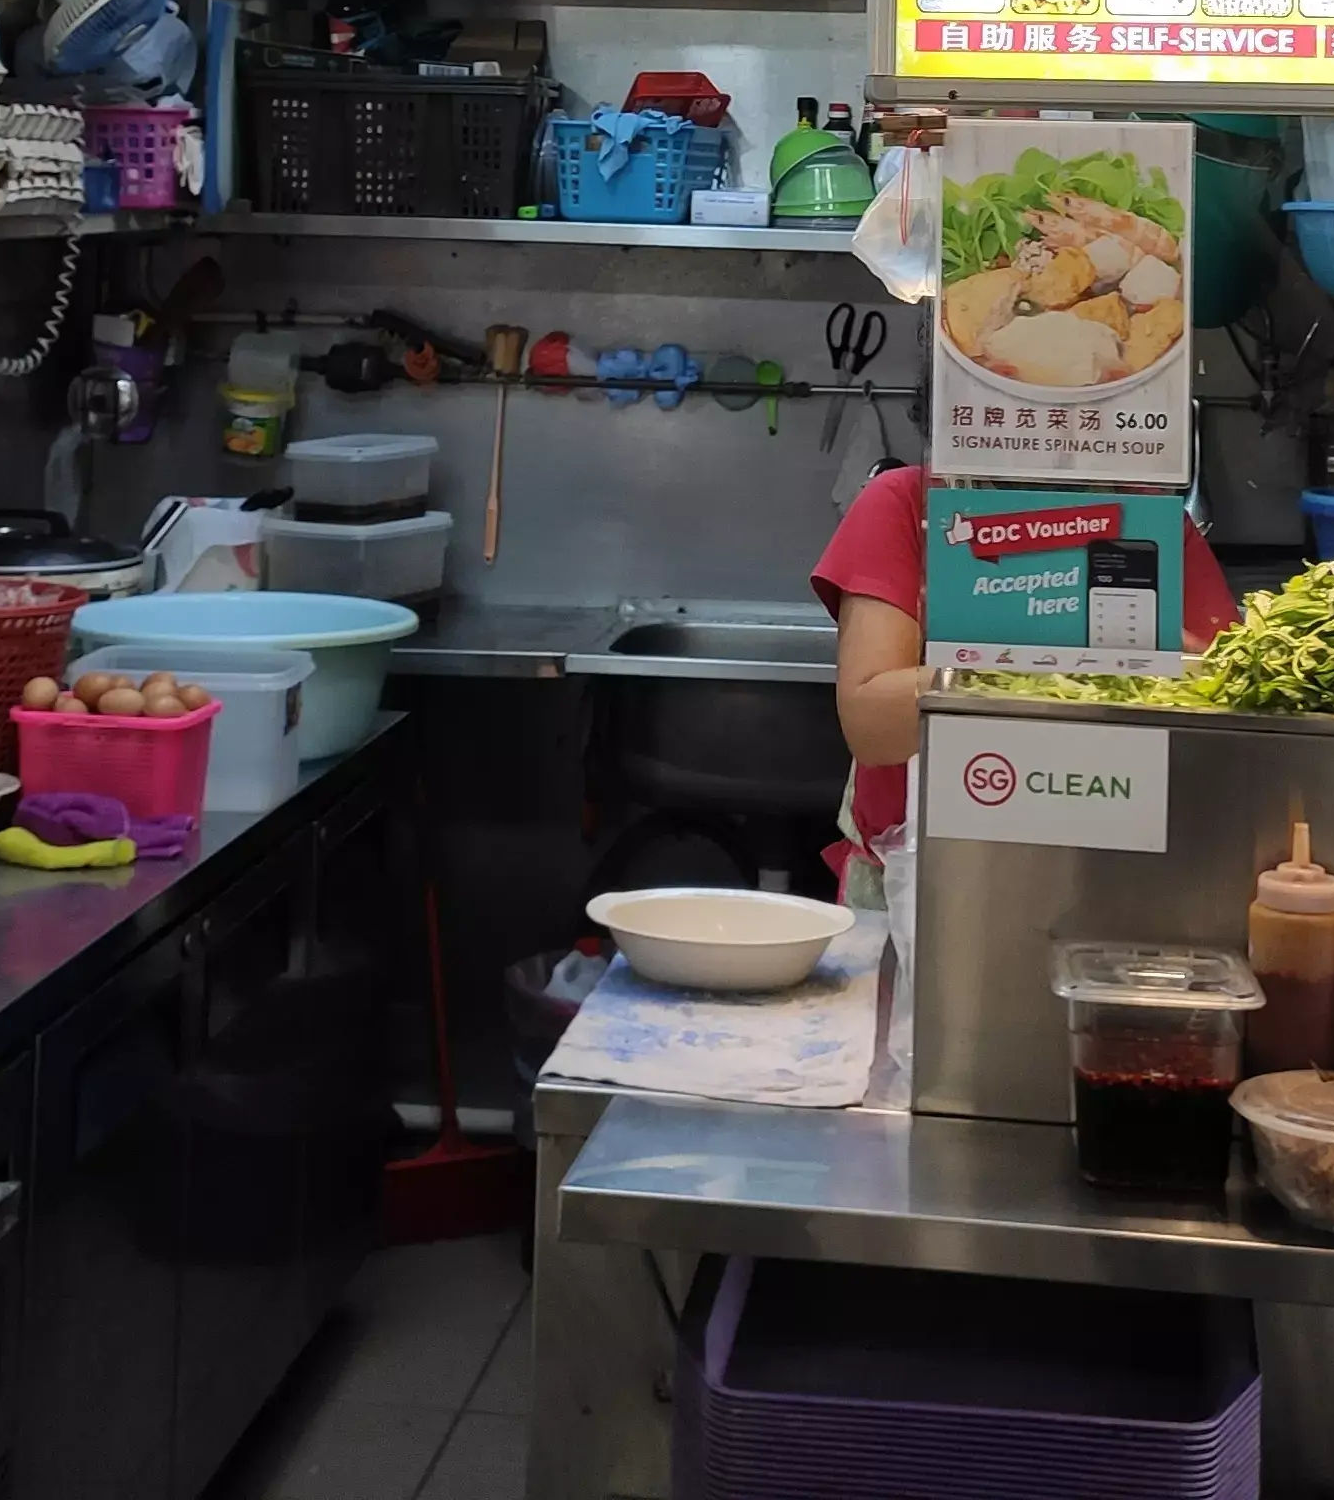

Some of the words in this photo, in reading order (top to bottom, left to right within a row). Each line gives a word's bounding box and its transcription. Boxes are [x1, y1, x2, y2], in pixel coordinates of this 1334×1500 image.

[941, 22, 1102, 53] 自助服务
[1110, 26, 1295, 54] SELF-SERVICE
[952, 404, 1101, 432] 招牌苋菜汤
[1114, 411, 1169, 432] $6.00
[952, 435, 1040, 451] SIGNATURE
[1044, 438, 1117, 454] SPINACH
[1122, 441, 1166, 456] SOUP
[976, 523, 1022, 546] CDC
[1025, 515, 1111, 540] Voucher
[972, 566, 1080, 596] Accepted
[1027, 595, 1080, 617] here
[970, 767, 1010, 792] SG
[1025, 771, 1131, 800] CLEAN
